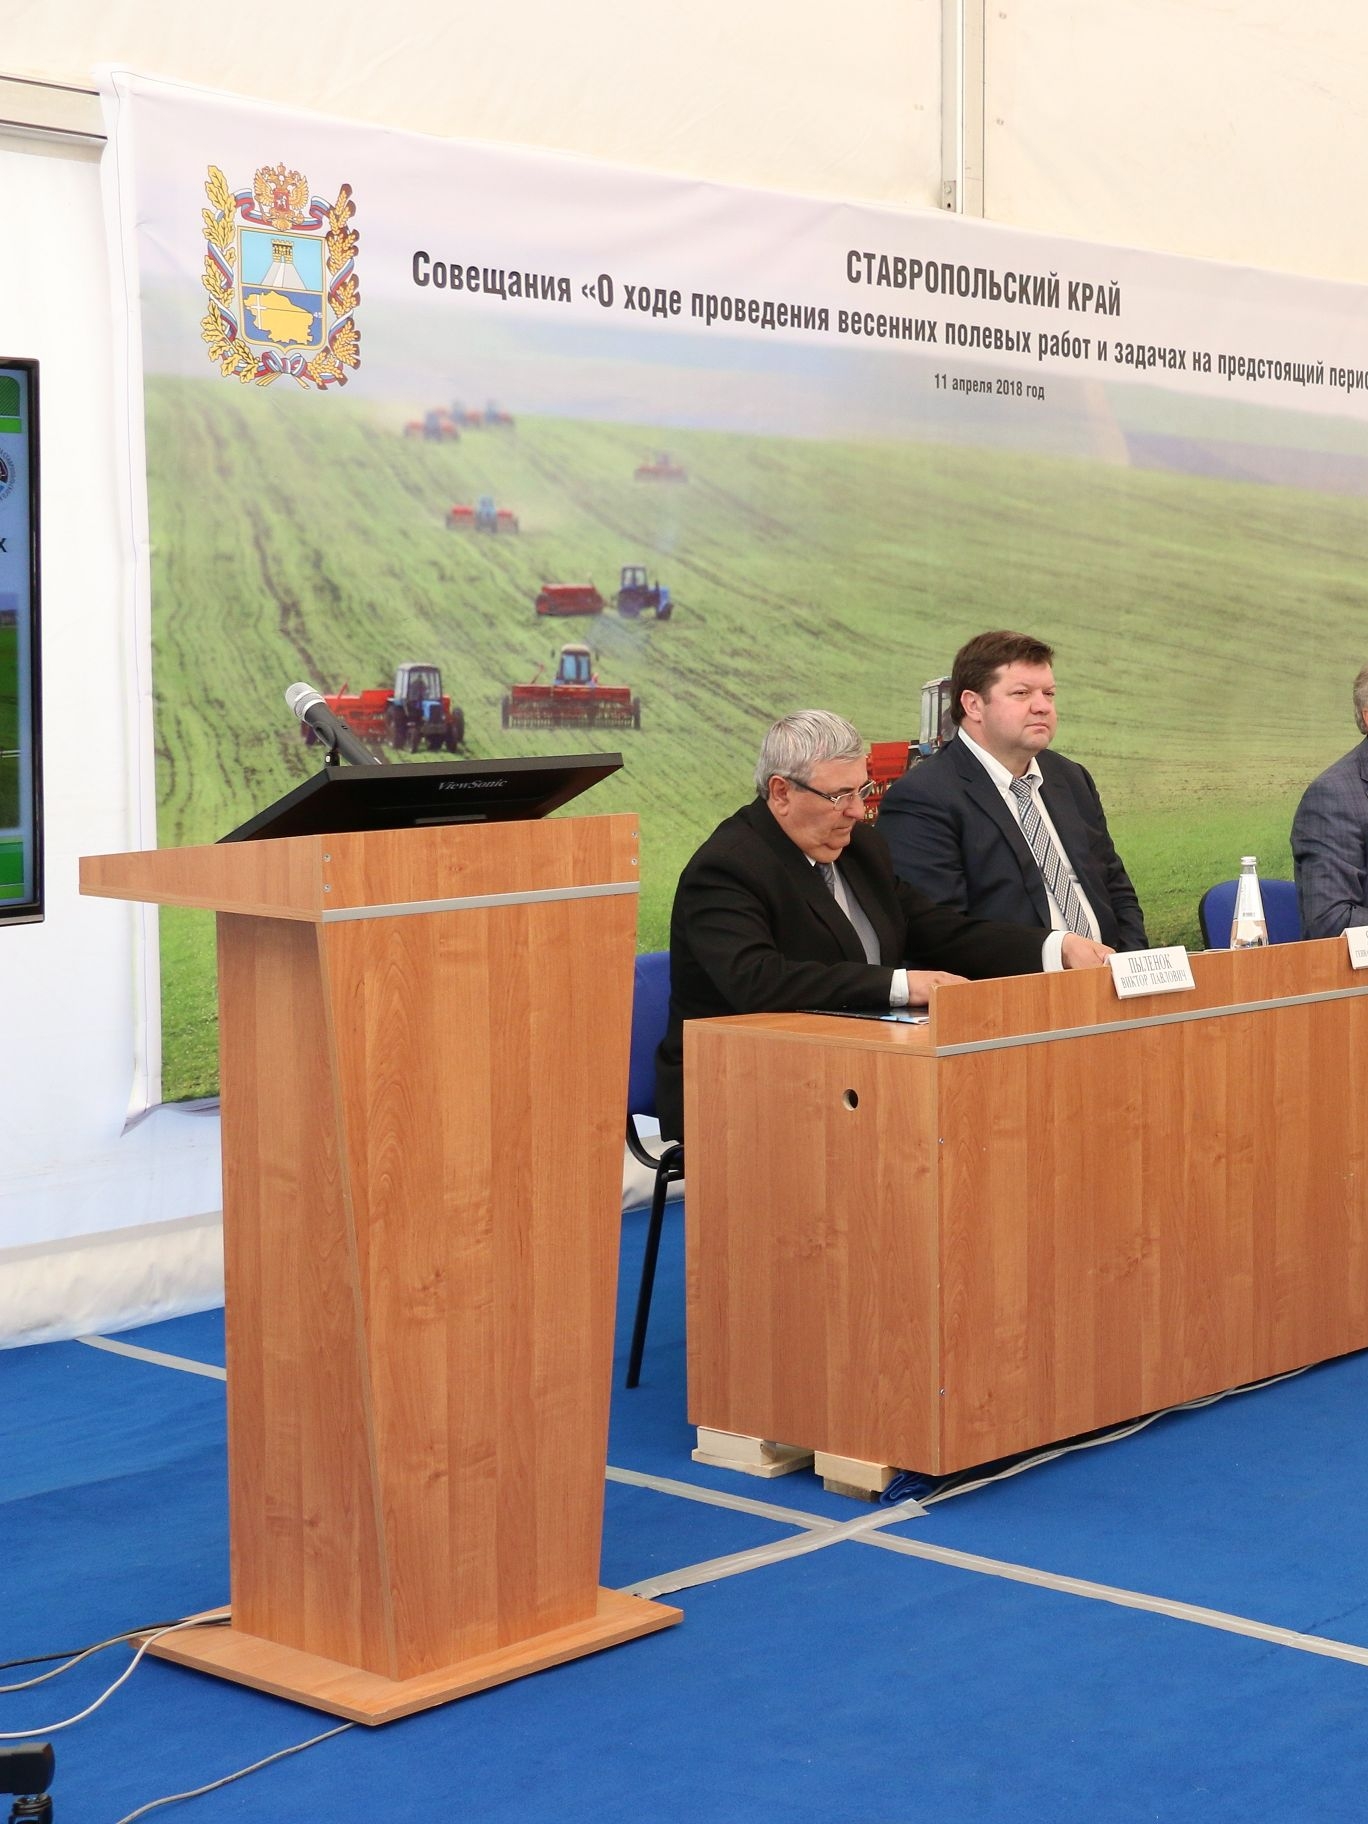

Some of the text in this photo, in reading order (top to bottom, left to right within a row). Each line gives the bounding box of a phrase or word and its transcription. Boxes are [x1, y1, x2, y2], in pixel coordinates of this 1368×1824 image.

[846, 249, 1121, 317] СТАВРОПОЛЬСКИЙ КРАЙ
[412, 250, 572, 303] Совещания
[581, 273, 614, 308] «О
[623, 284, 682, 319] ходе
[691, 292, 830, 332] проведения
[838, 309, 938, 344] весенних
[945, 322, 1032, 354] полевых
[1038, 329, 1092, 362] работ
[1097, 339, 1108, 362] и
[1113, 341, 1187, 371] задачах
[1192, 350, 1212, 373] на
[1217, 353, 1325, 388] предстоящий
[934, 372, 1045, 401] 11 апреля 2018 год
[438, 779, 508, 790] ViewSonic
[1127, 953, 1173, 974] ПЫЛЕНОК
[1120, 969, 1188, 989] ВИКТОР ПАВЛОВИЧ
